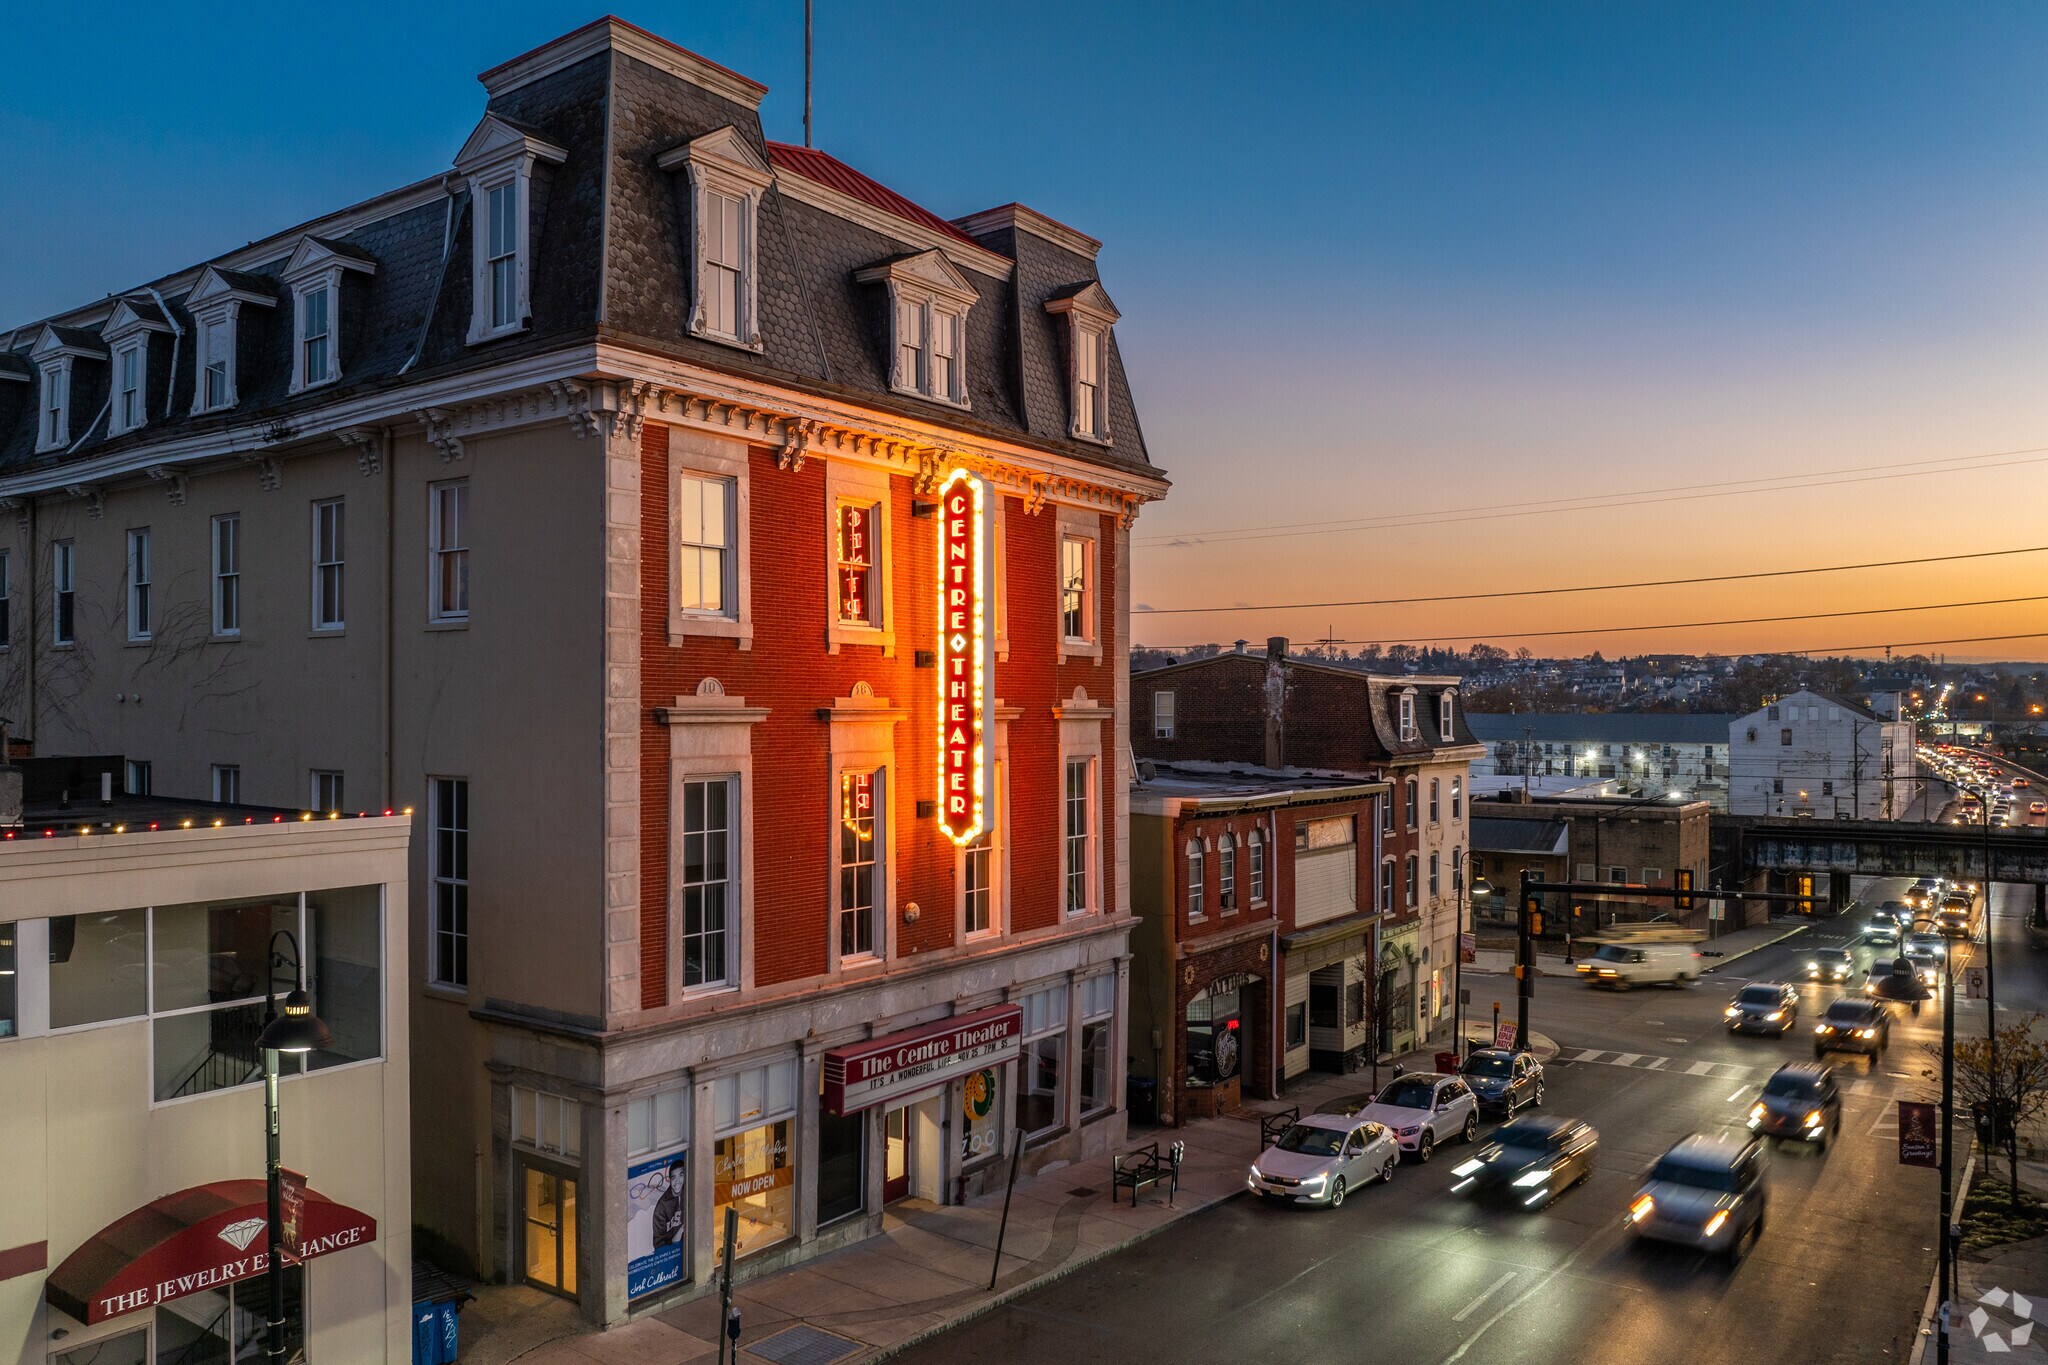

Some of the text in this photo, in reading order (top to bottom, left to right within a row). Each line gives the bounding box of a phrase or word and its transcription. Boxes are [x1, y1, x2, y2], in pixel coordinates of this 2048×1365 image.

[950, 496, 966, 814] CENTRE THEATER
[859, 1020, 1010, 1079] The Centre Theater
[870, 1078, 885, 1090] IT'S
[889, 1074, 895, 1084] A
[898, 1062, 935, 1081] WONDERFUL
[958, 1050, 970, 1062] NOV
[971, 1048, 979, 1059] 25
[983, 1043, 997, 1055] 7PM
[962, 1129, 996, 1157] ZOO
[1902, 1150, 1934, 1159] Greetings
[731, 1174, 775, 1198] NOW OPEN
[100, 1287, 149, 1316] THE
[153, 1258, 249, 1305] JEWELRY
[630, 1265, 679, 1295] Josh Culbreath
